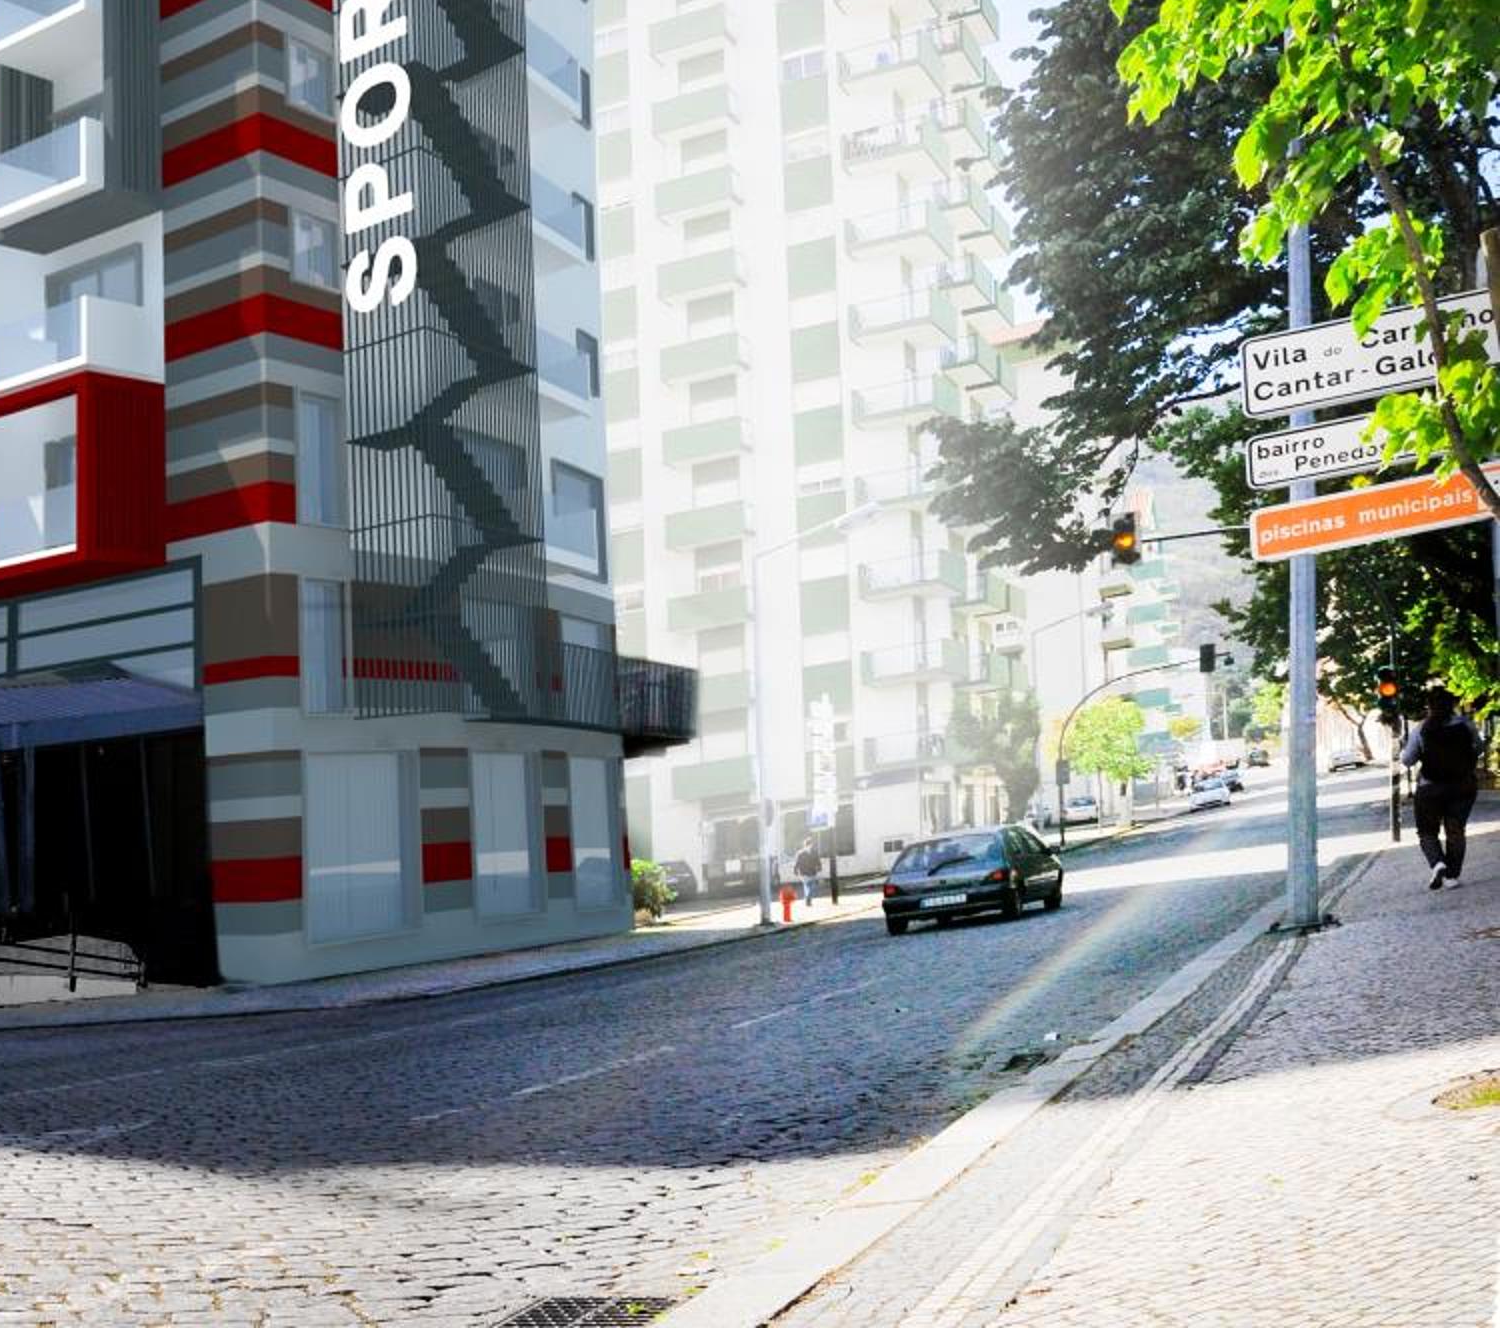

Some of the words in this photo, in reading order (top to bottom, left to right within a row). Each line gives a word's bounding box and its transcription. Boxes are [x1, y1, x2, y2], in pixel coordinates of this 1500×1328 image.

[1253, 347, 1307, 371] Vila
[1257, 435, 1325, 461] bairro
[1260, 513, 1346, 545] piscinas
[1358, 486, 1474, 525] municipais
